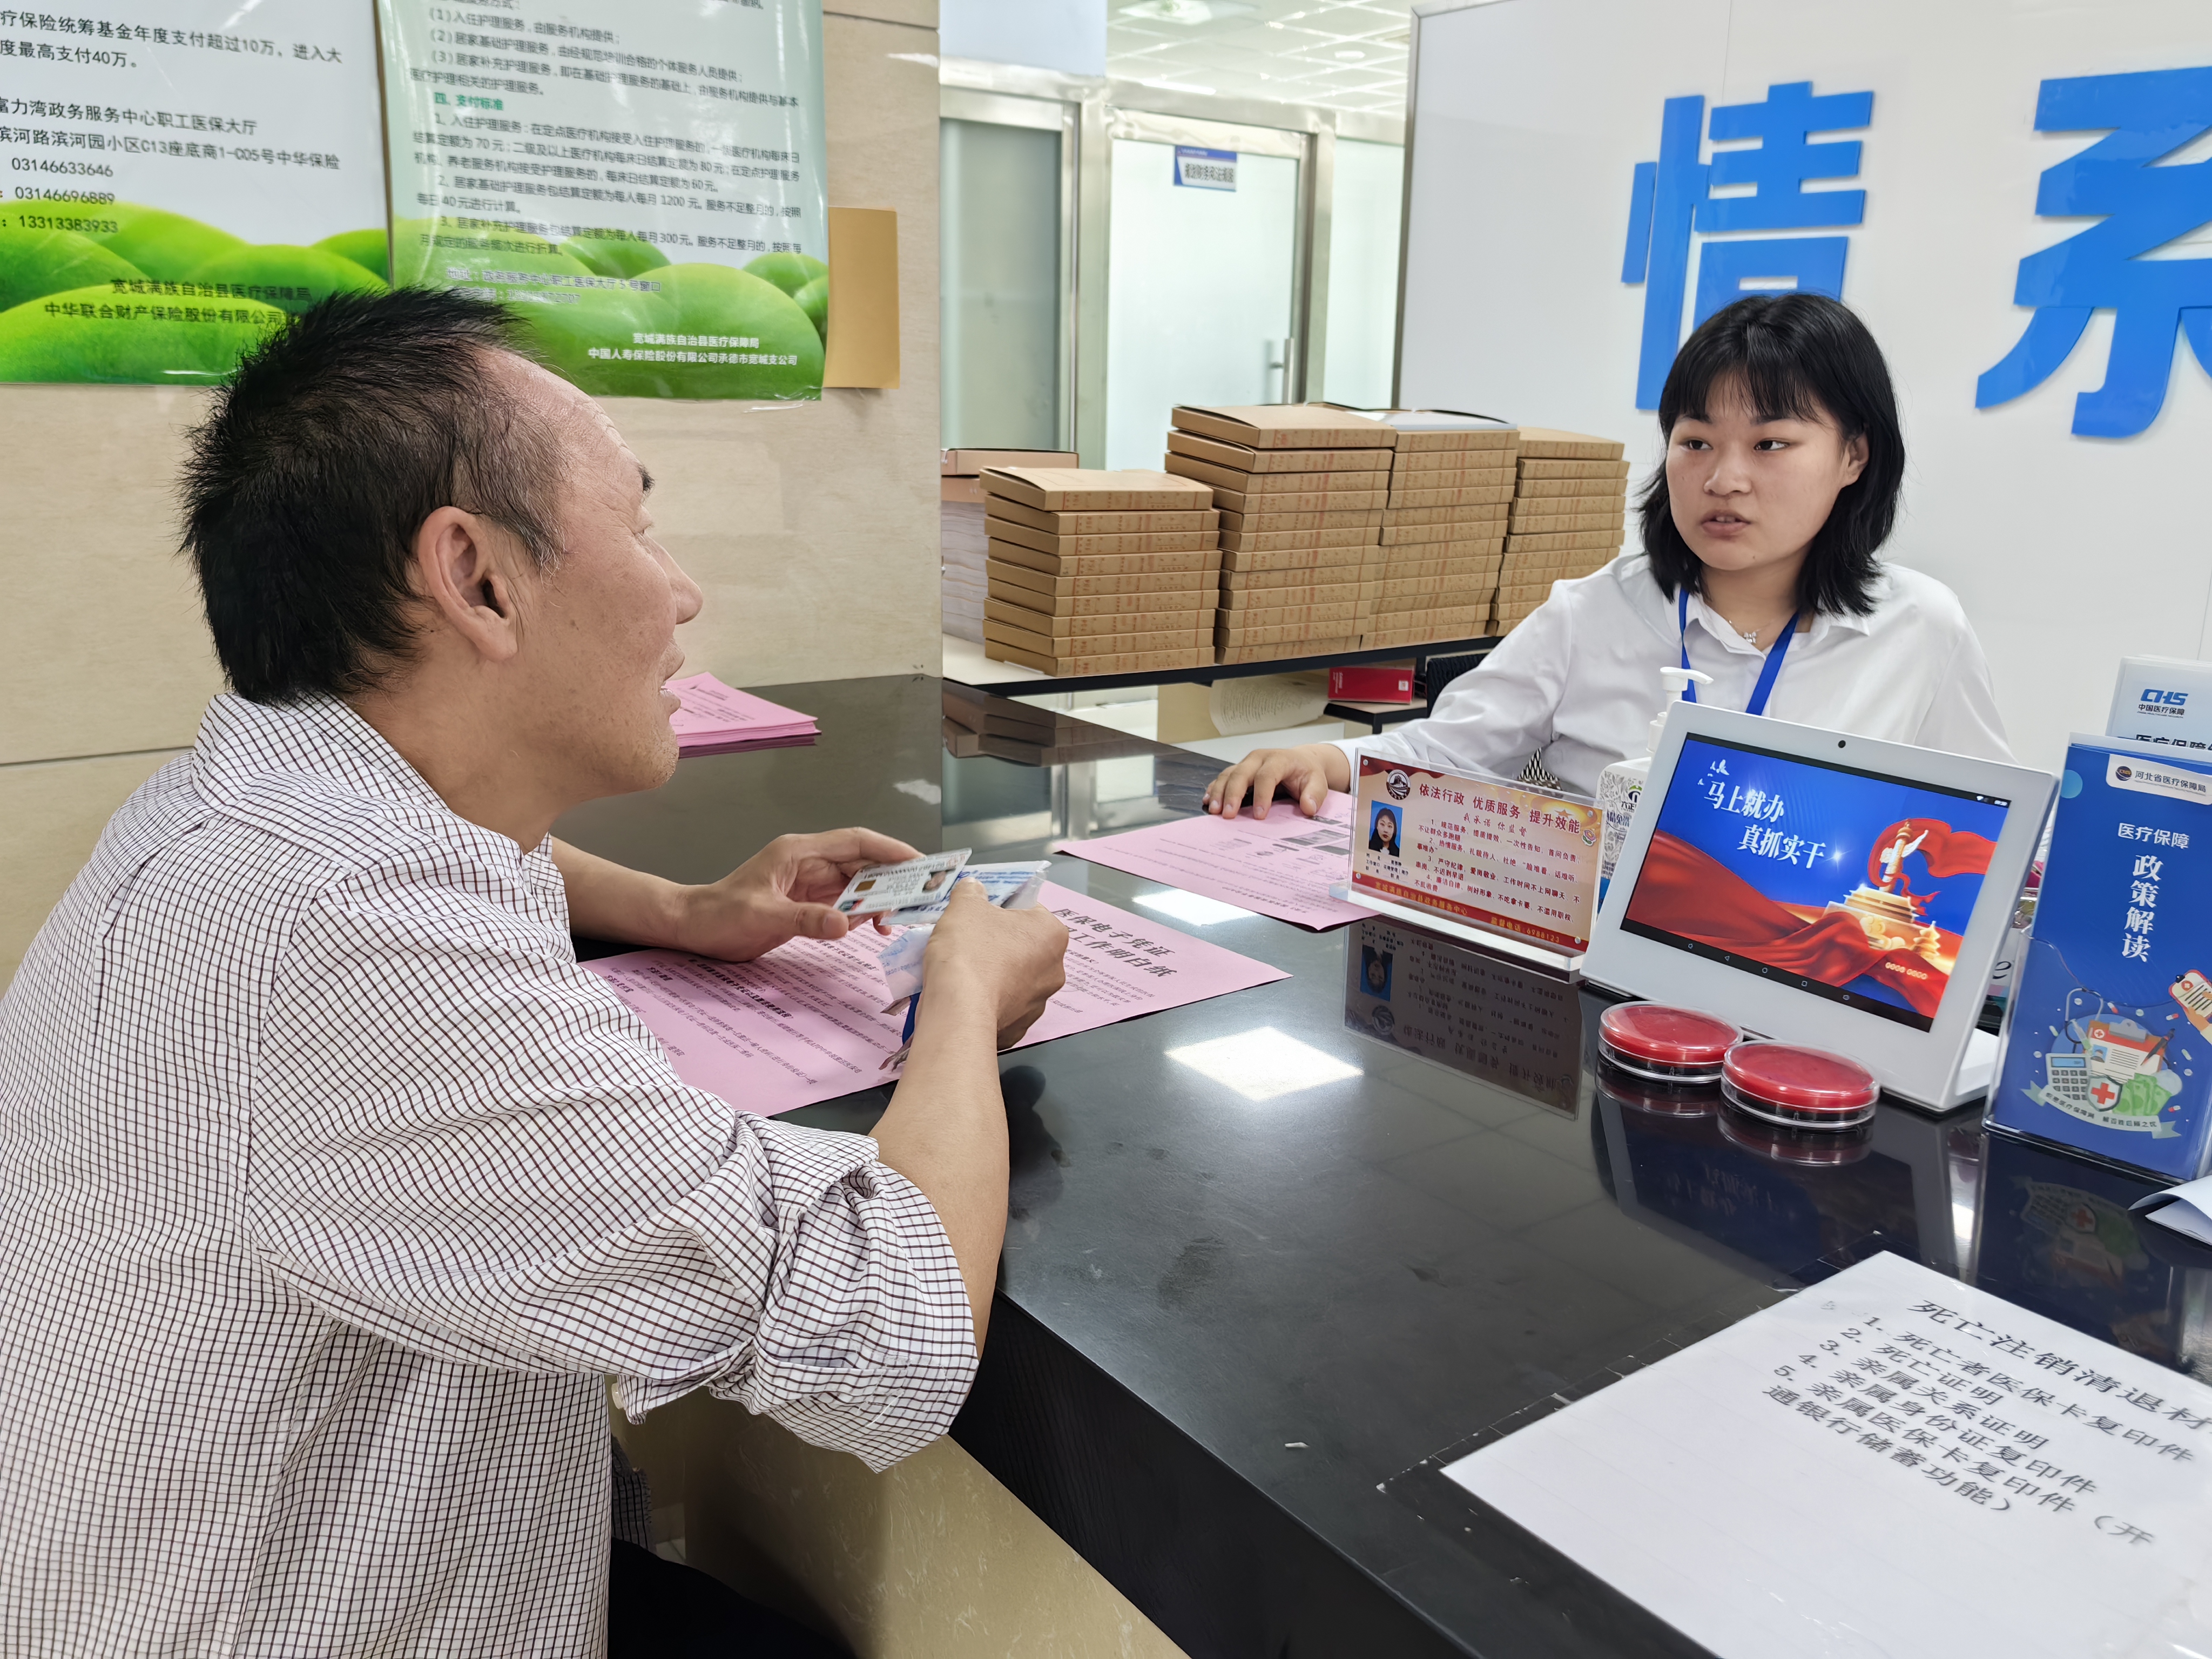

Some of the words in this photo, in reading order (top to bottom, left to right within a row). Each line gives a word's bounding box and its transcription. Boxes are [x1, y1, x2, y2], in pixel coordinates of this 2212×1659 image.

[11, 157, 113, 177] 03146633646
[2138, 704, 2185, 716] 中国医疗保障
[1704, 781, 1785, 822] 马上就办
[2134, 770, 2206, 793] 河北省医疗保障局
[1419, 783, 1465, 806] 依法行政
[1473, 795, 1521, 819] 优质服务
[1529, 809, 1581, 834] 提升效能
[1737, 824, 1826, 869] 真抓实干
[2117, 822, 2190, 849] 医疗保障
[2122, 855, 2164, 962] 政策解读
[1051, 909, 1176, 957] 医保电子凭证
[1906, 1299, 2212, 1433] 死亡注销清退材
